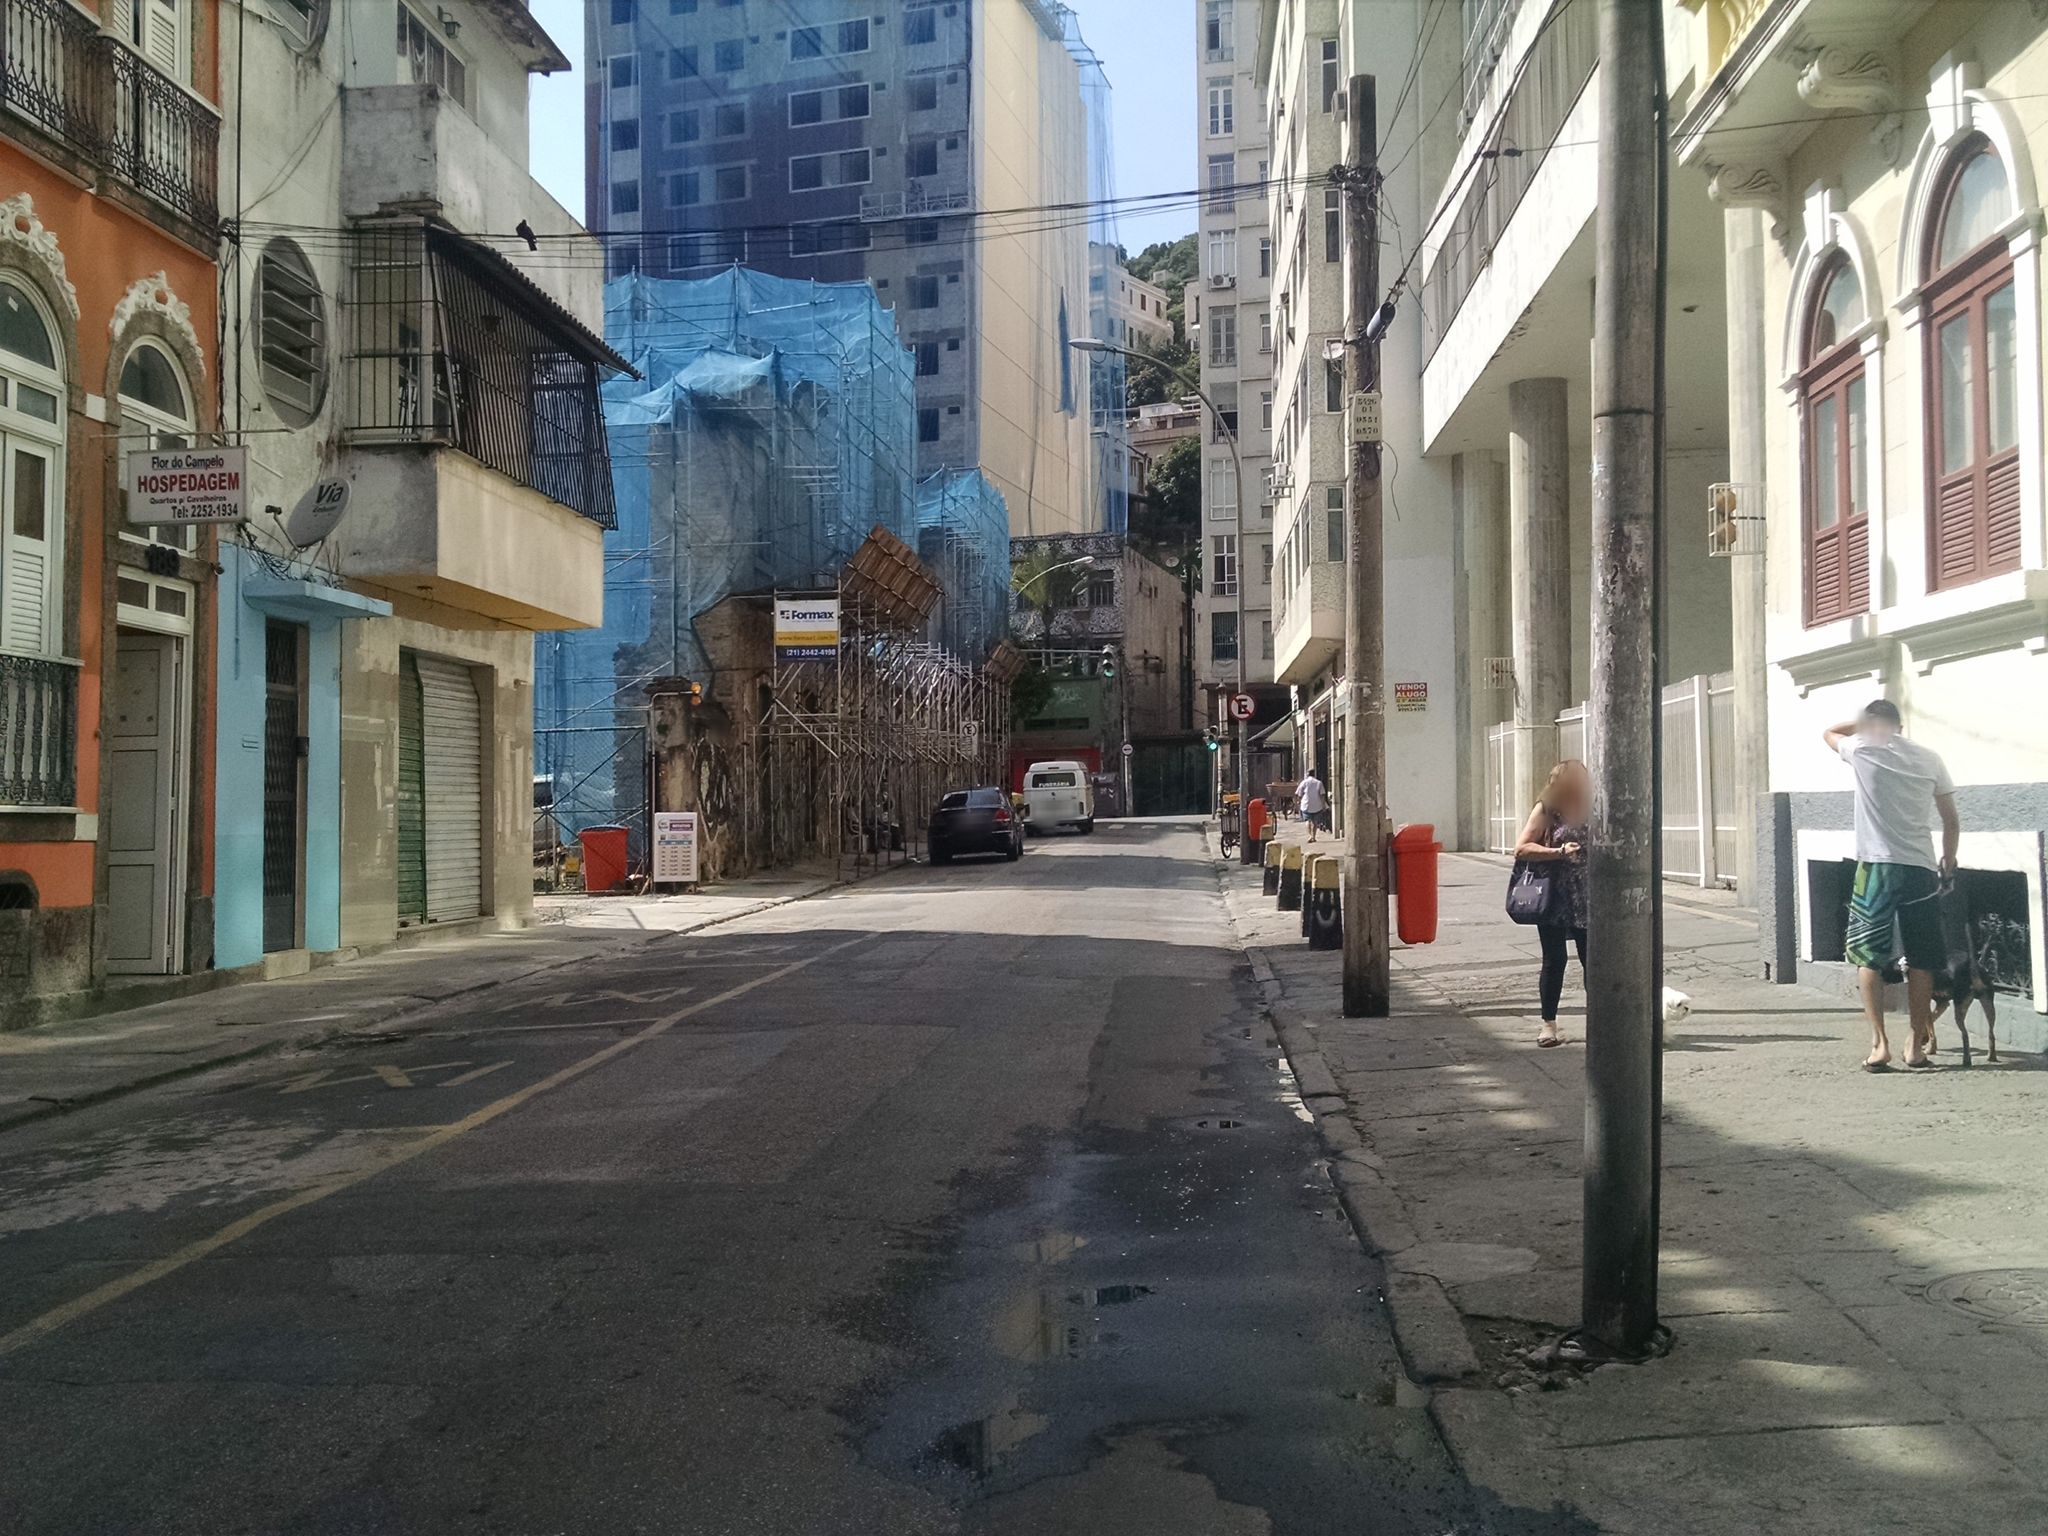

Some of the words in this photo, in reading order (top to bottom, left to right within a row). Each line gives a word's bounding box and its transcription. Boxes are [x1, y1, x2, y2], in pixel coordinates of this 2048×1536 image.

[151, 456, 168, 469] Flor
[171, 456, 183, 468] do
[185, 454, 224, 470] Campelo
[137, 472, 240, 493] HOSPEDAGEM
[316, 482, 344, 503] Via
[150, 497, 177, 505] Quartos
[171, 505, 188, 519] Tel:
[190, 503, 238, 518] 2252-1934
[791, 610, 834, 620] Formax
[787, 649, 800, 657] (21)
[1396, 683, 1426, 691] VENDO
[1238, 698, 1248, 715] E
